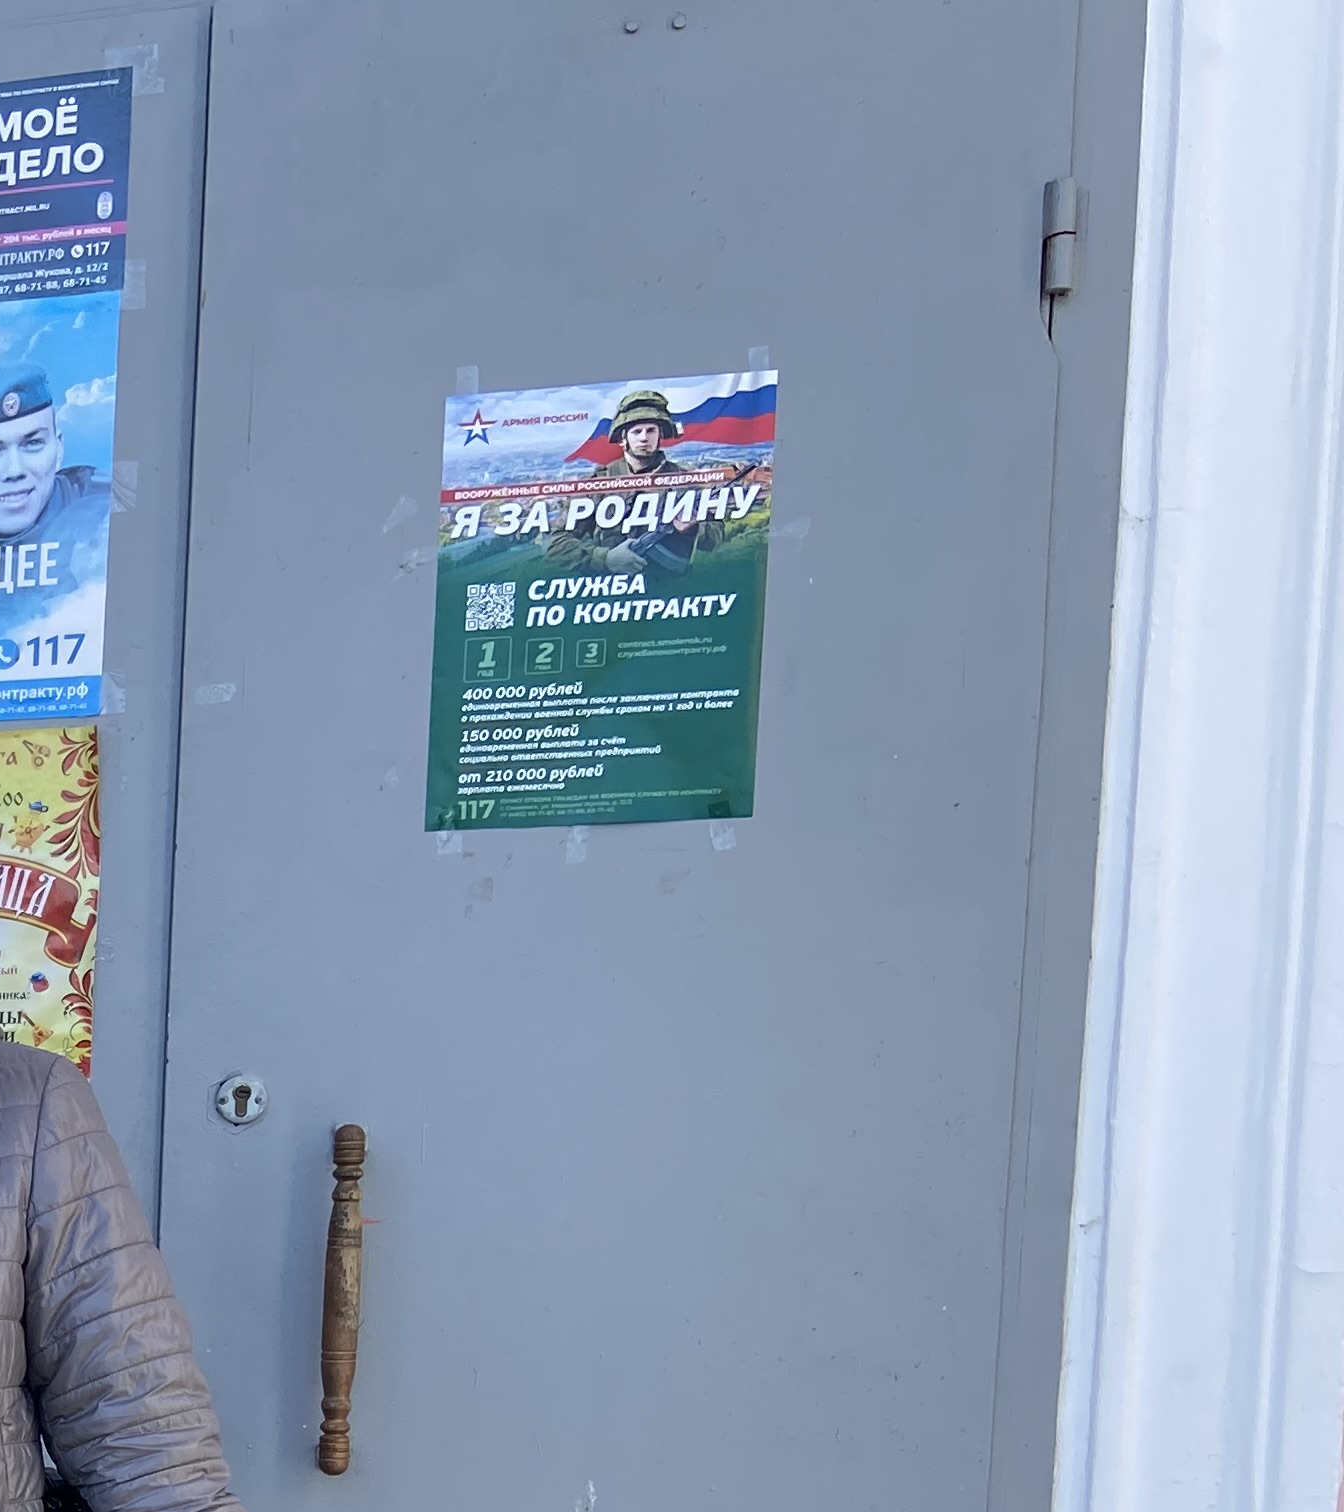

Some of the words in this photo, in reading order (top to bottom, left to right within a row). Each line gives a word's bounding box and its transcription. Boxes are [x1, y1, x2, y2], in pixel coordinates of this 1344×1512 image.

[42, 228, 74, 241] рублей
[84, 226, 112, 235] месяц
[86, 241, 110, 256] 117
[86, 262, 109, 273] 12/2
[502, 417, 540, 428] АРМИЯ
[544, 412, 588, 424] РОССИИ
[454, 484, 540, 500] ВООРУЖЁННЫЕ
[542, 482, 574, 494] СИЛЫ
[577, 475, 652, 490] РОССИЙСКОЙ
[654, 472, 724, 486] ФЕДЕРАЦИИ
[450, 506, 481, 539] Я
[494, 501, 550, 536] ЗА
[564, 484, 762, 535] РОДИНУ
[527, 573, 646, 601] СЛУЖБА
[525, 605, 565, 628] ПО
[574, 593, 739, 624] КОНТРАКТУ
[26, 633, 86, 667] 117
[478, 641, 496, 668] 1
[536, 642, 555, 664] 2
[585, 642, 598, 658] 3
[462, 687, 492, 701] 400
[496, 685, 526, 700] 000
[528, 681, 583, 700] рублей
[590, 696, 618, 704] после
[461, 715, 468, 723] о
[576, 706, 613, 718] службы
[616, 705, 651, 716] сроком
[652, 704, 666, 712] на
[704, 700, 734, 709] более
[461, 729, 490, 742] 150
[492, 727, 522, 741] 000
[526, 724, 580, 742] рублей
[587, 738, 598, 746] за
[600, 736, 626, 746] счёт
[458, 773, 481, 784] от
[485, 770, 513, 782] 210
[516, 768, 546, 782] 000
[549, 763, 604, 782] рублей
[457, 800, 496, 820] 117
